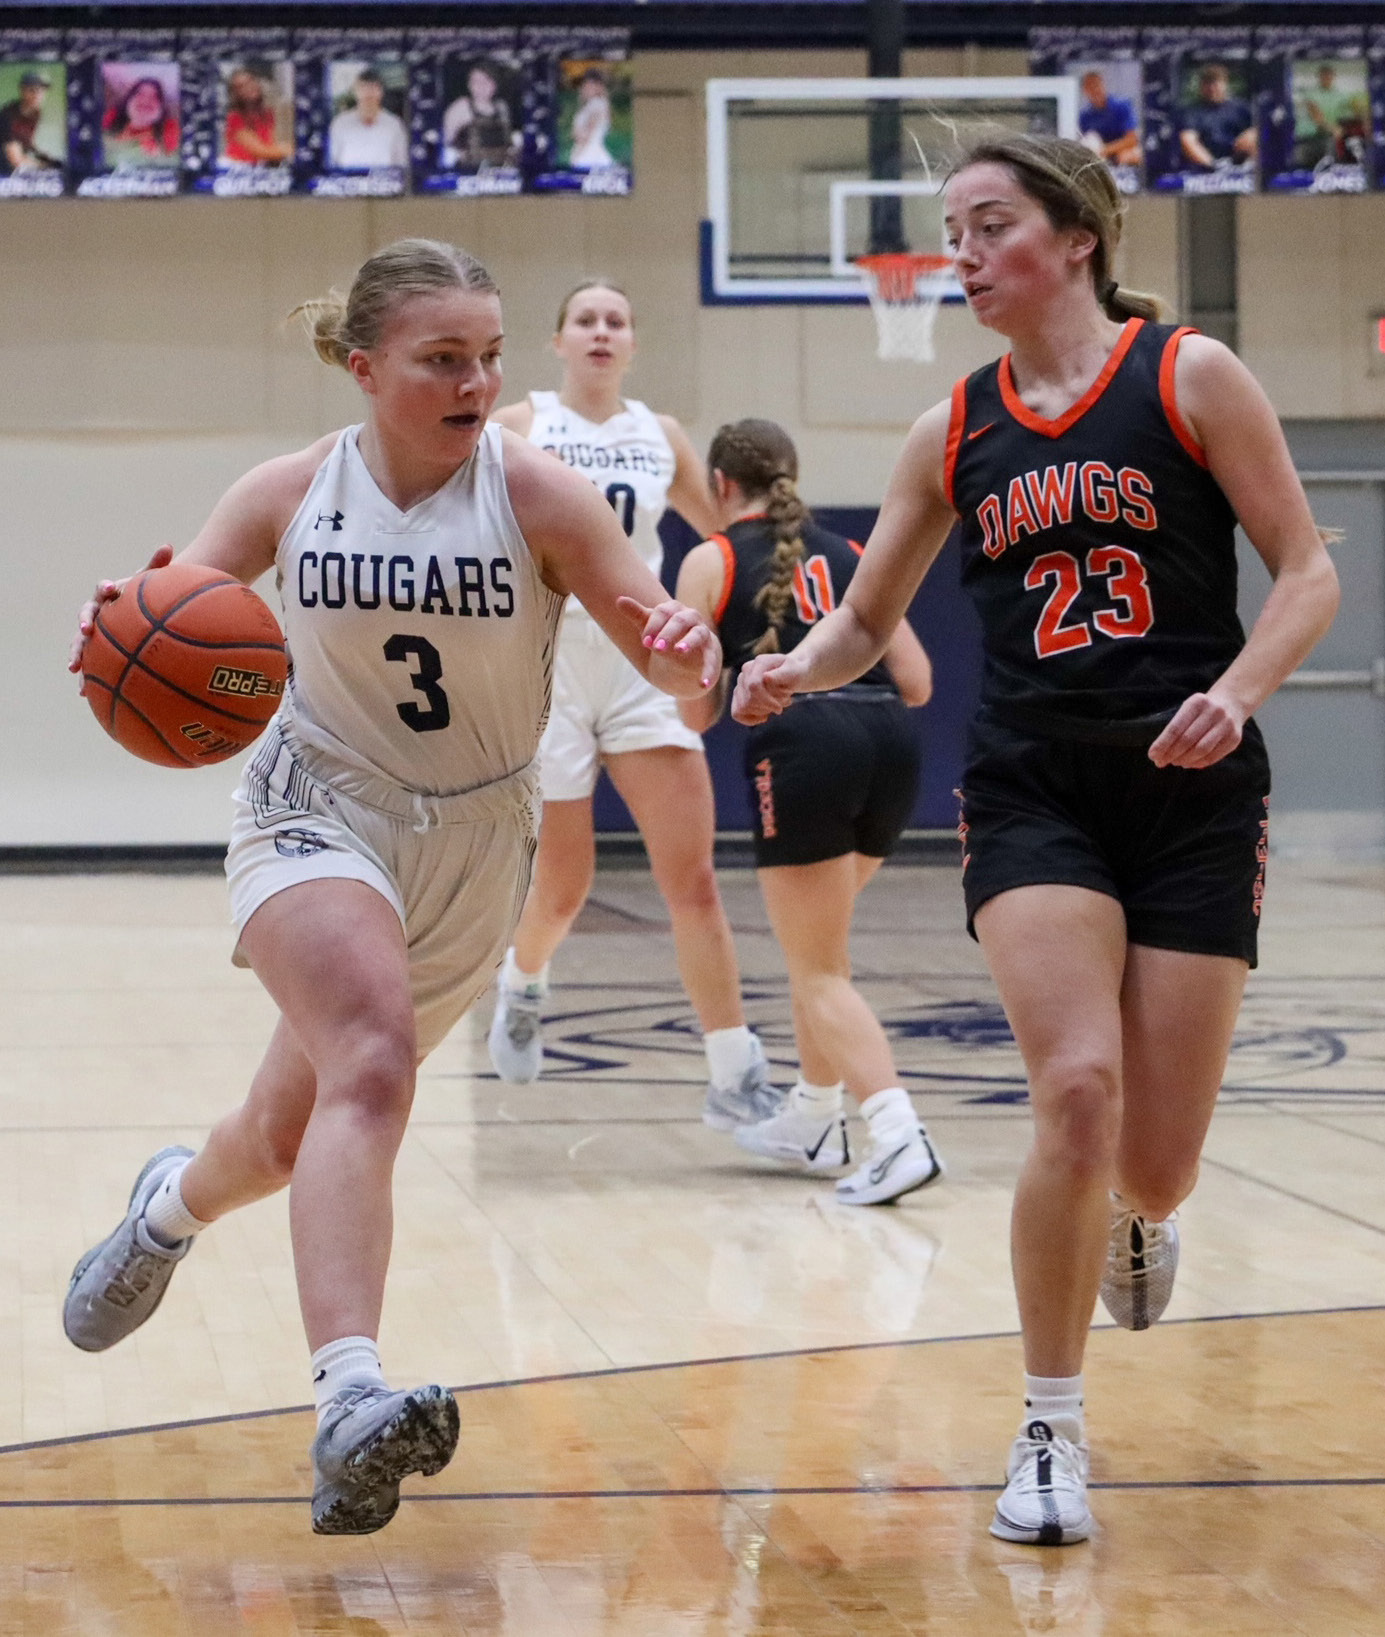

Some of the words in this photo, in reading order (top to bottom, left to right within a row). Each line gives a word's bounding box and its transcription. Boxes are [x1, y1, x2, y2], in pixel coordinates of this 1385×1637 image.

[976, 460, 1158, 561] DAWGS
[298, 551, 515, 618] COUGARS
[1023, 545, 1155, 660] 23
[382, 633, 451, 733] 3
